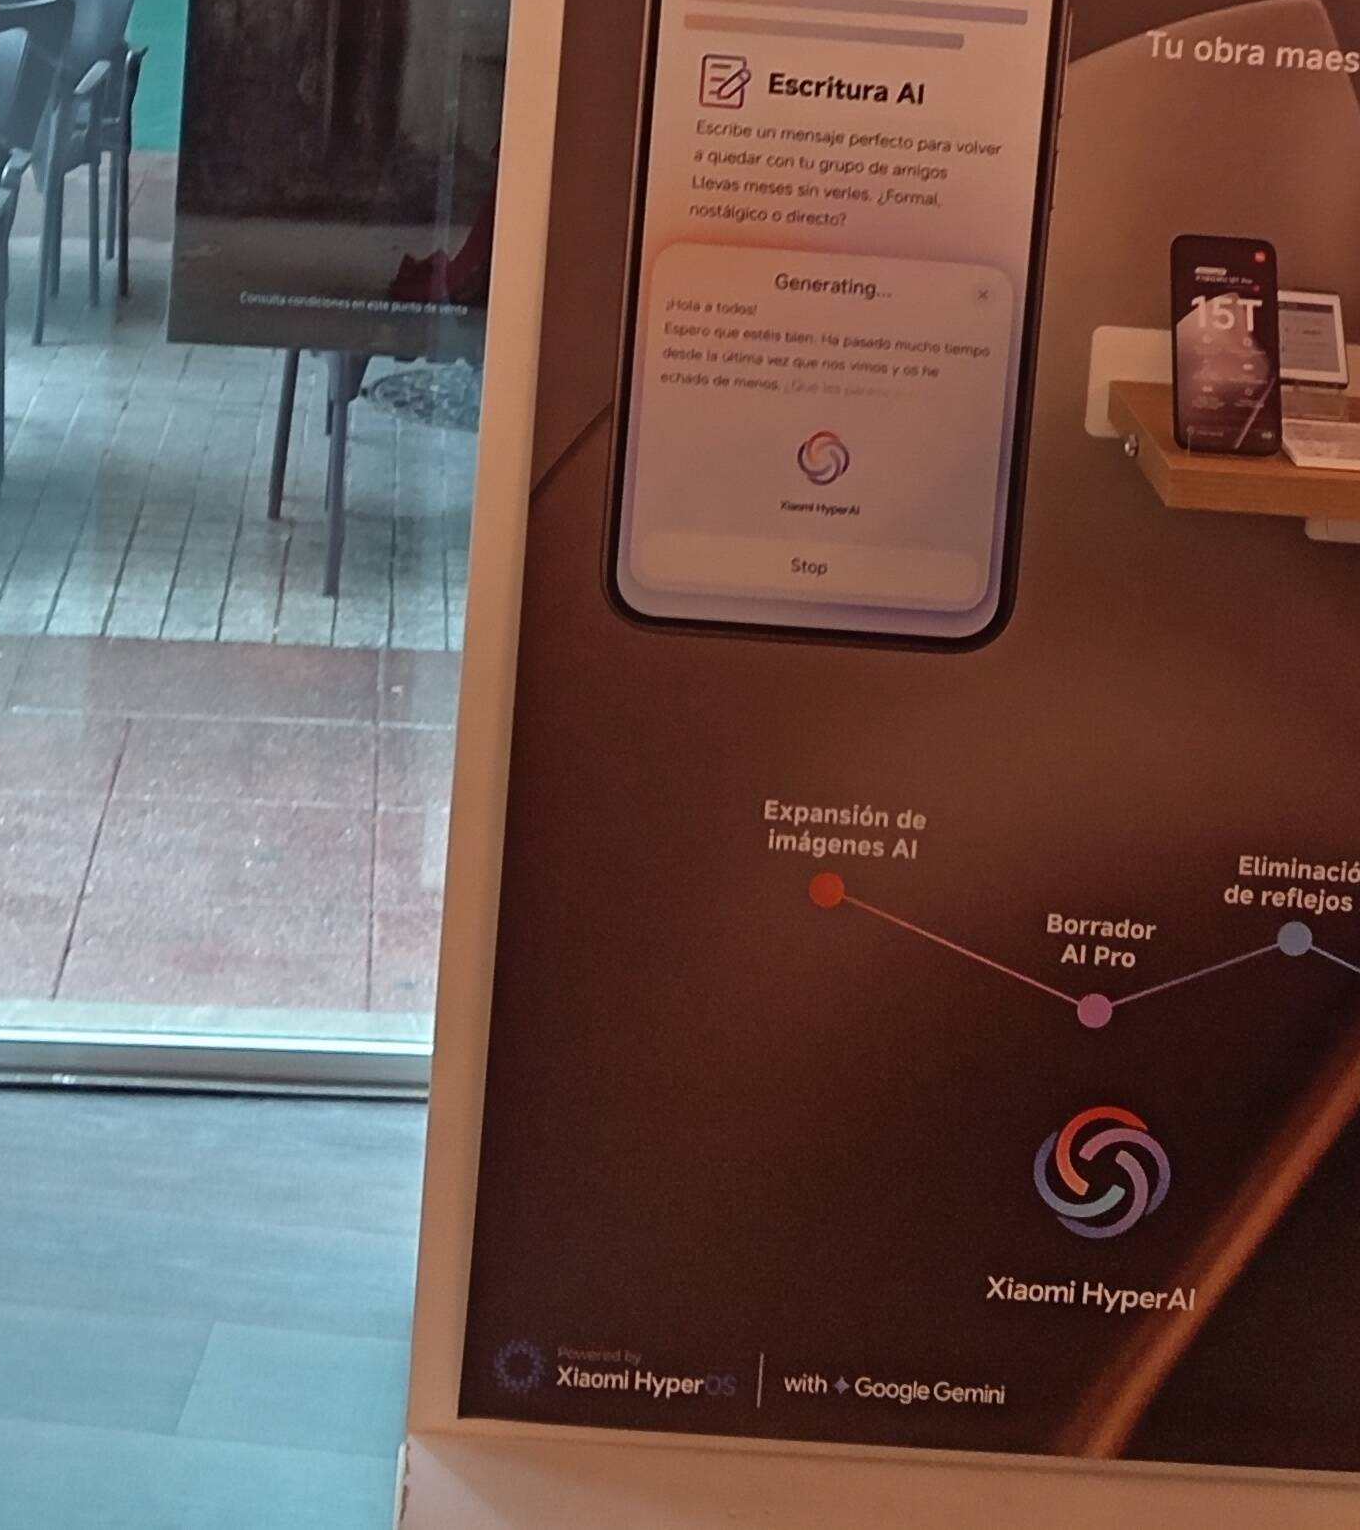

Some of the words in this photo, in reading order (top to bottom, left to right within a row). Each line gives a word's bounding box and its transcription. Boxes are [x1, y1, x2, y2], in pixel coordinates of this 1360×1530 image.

[1146, 30, 1184, 61] Tu
[1194, 34, 1266, 67] obra
[768, 72, 889, 103] Escritura
[896, 82, 926, 106] AI
[695, 119, 752, 140] Escribe
[756, 128, 777, 142] un
[780, 126, 844, 148] mensaje
[848, 130, 914, 154] perfecto
[917, 137, 952, 156] para
[955, 140, 1002, 157] volver
[694, 152, 704, 163] a
[707, 148, 762, 170] quedar
[765, 155, 795, 169] con
[798, 155, 815, 169] tu
[818, 159, 864, 178] grupo
[868, 159, 888, 174] de
[891, 162, 948, 182] amigos
[692, 176, 739, 194] Llevas
[743, 181, 793, 197] meses
[797, 182, 819, 197] sin
[823, 184, 873, 202] verles.
[689, 203, 768, 224] nostálgico
[771, 210, 782, 222] o
[786, 208, 847, 228] directo?
[774, 273, 892, 299] Generating...
[1190, 295, 1263, 334] 15T
[664, 323, 711, 341] Espero
[714, 327, 740, 342] que
[743, 325, 782, 344] estéis
[843, 335, 892, 354] pasado
[894, 338, 941, 355] mucho
[943, 342, 991, 361] tiempo
[662, 346, 703, 363] desde
[706, 348, 719, 363] la
[723, 348, 763, 367] última
[768, 354, 790, 368] vez
[793, 356, 819, 373] que
[821, 358, 846, 371] nos
[849, 359, 889, 375] vimos
[892, 364, 901, 378] y
[903, 365, 919, 378] os
[660, 371, 709, 388] echado
[712, 374, 731, 389] de
[791, 558, 828, 577] Stop
[763, 798, 890, 829] Expansión
[896, 808, 927, 832] de
[767, 826, 885, 860] imágenes
[891, 835, 918, 860] AI
[1223, 883, 1253, 907] de
[1259, 884, 1353, 916] reflejos
[1046, 913, 1157, 941] Borrador
[1060, 942, 1087, 966] AI
[1093, 944, 1137, 969] Pro
[986, 1275, 1077, 1306] Xiaomi
[1082, 1281, 1197, 1315] HyperAI
[557, 1345, 622, 1362] Powered
[625, 1348, 642, 1366] by
[556, 1366, 630, 1391] Xiaomi
[634, 1370, 736, 1400] HyperOS
[784, 1375, 828, 1395] with
[855, 1376, 930, 1405] Google
[933, 1381, 1005, 1405] Gemini
